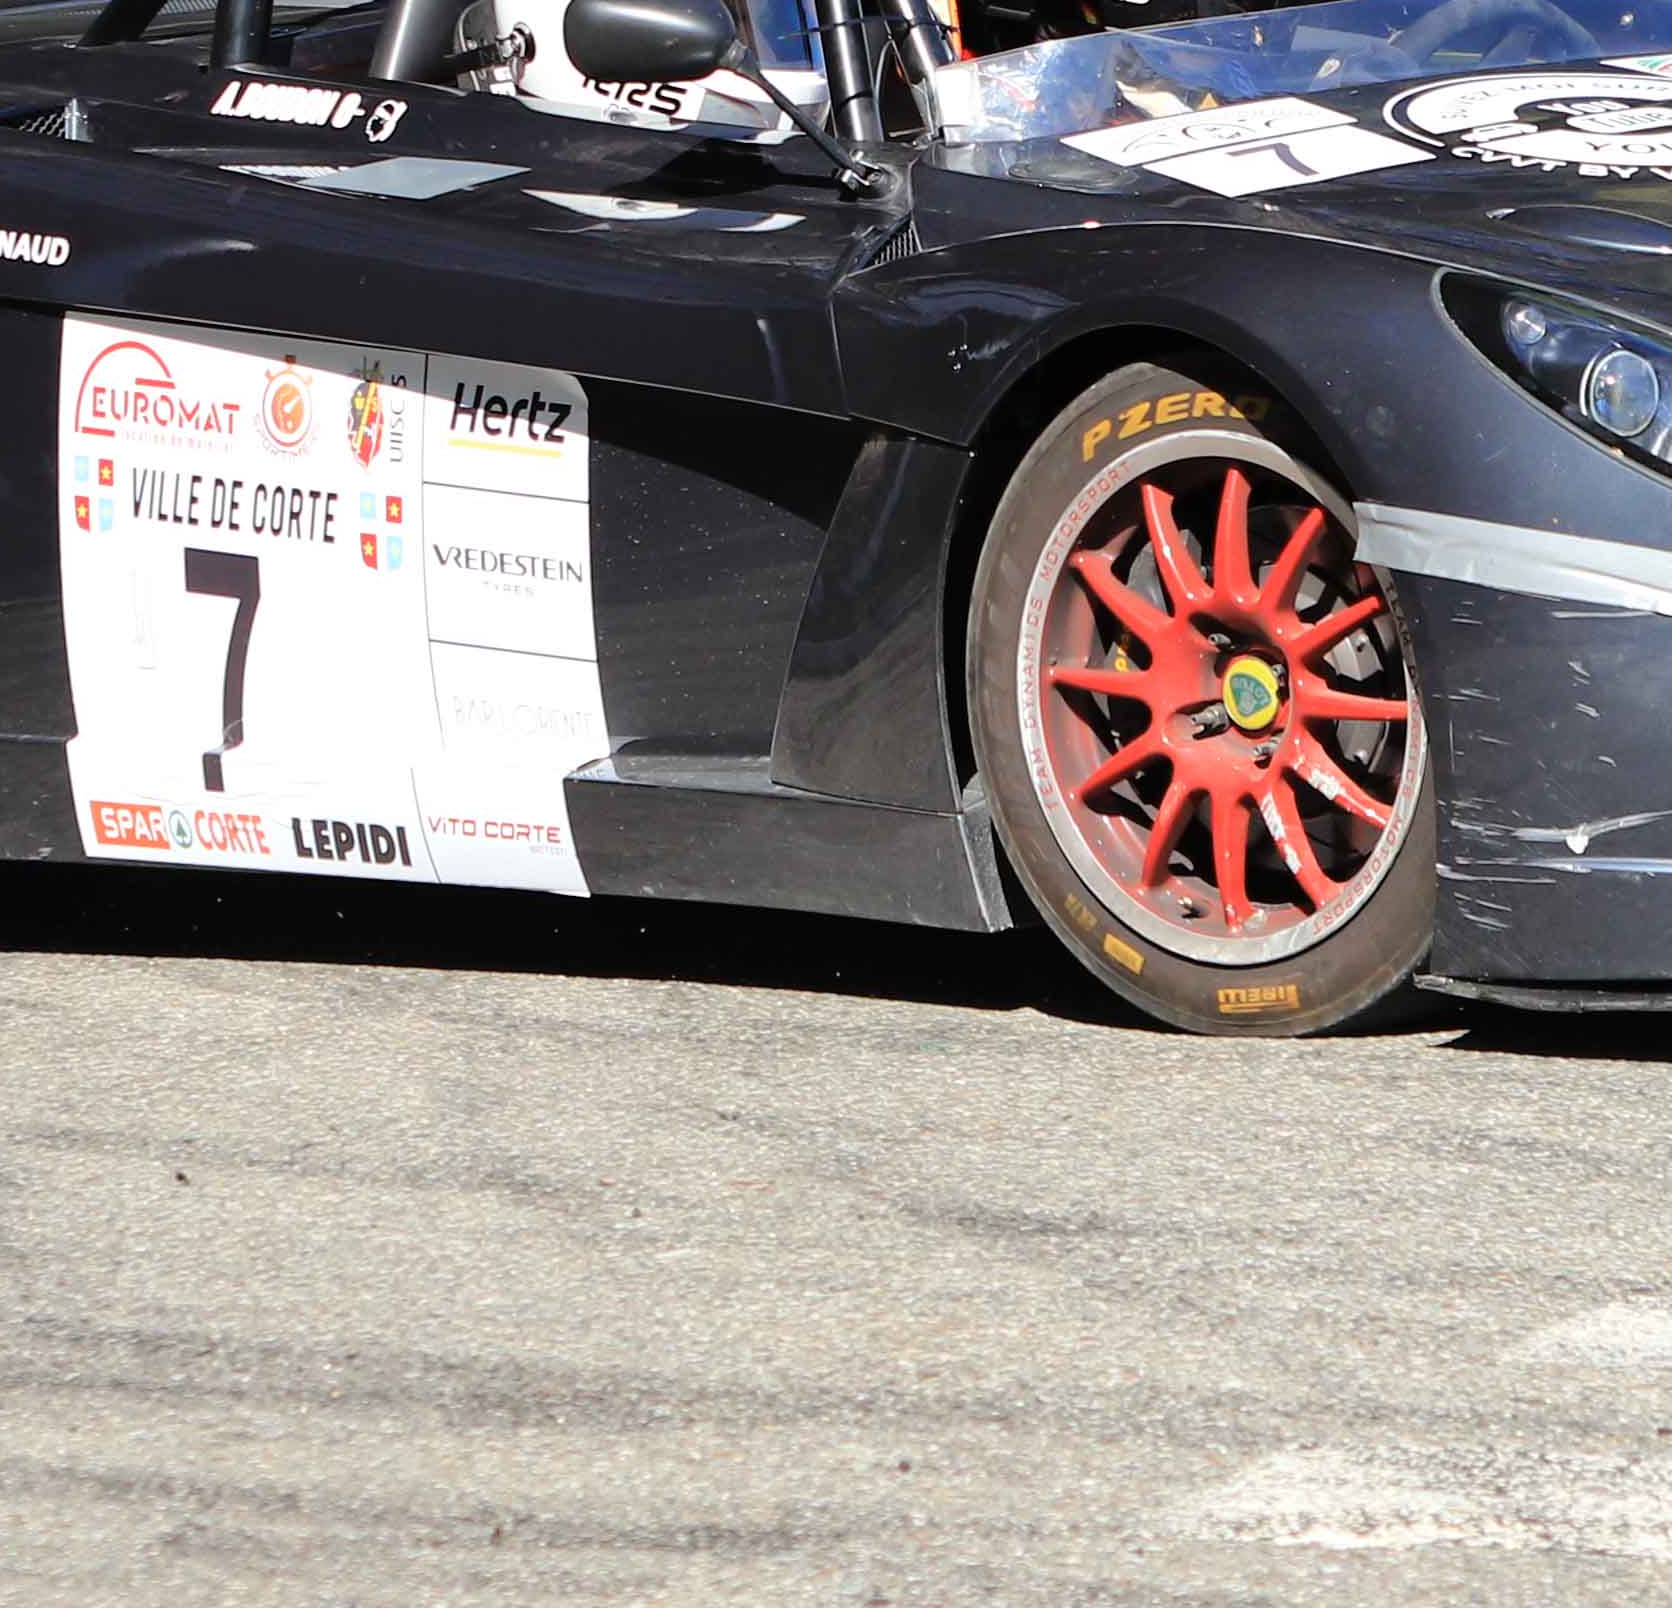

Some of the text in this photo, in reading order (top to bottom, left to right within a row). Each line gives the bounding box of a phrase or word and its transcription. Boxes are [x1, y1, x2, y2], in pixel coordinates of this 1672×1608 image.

[1225, 141, 1321, 178] 7
[1577, 164, 1647, 181] BY
[90, 385, 241, 439] EUROMAT
[449, 381, 573, 444] Hertz
[132, 466, 338, 545] VILLE DE CORTE
[1038, 458, 1132, 584] MOTORSPORT
[432, 543, 584, 583] VREDESTEIN
[184, 546, 261, 792] 7
[1025, 740, 1059, 812] TEAM
[97, 805, 271, 855] SPAR CORTE
[290, 817, 413, 867] LEPIDI
[483, 818, 562, 844] CORTE
